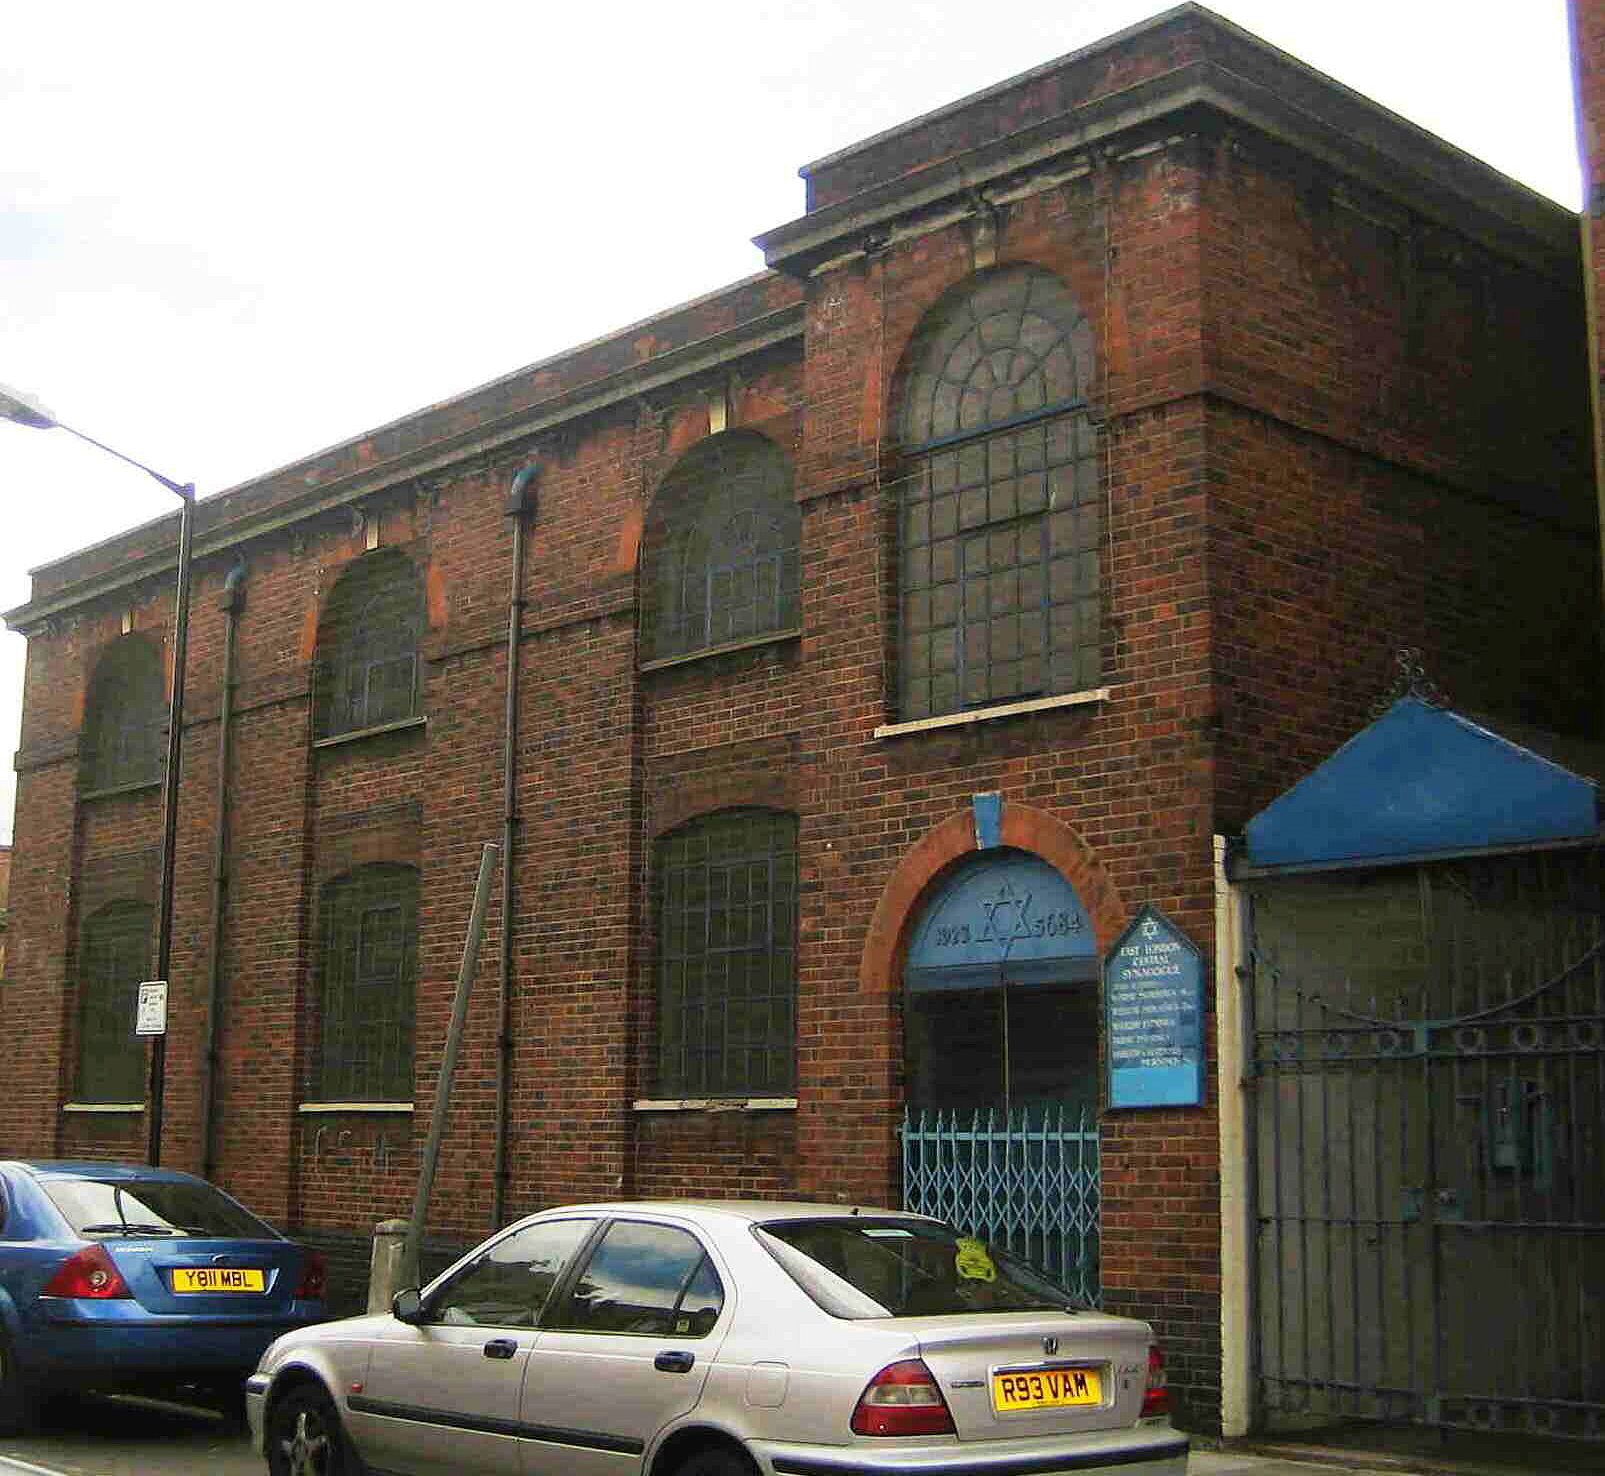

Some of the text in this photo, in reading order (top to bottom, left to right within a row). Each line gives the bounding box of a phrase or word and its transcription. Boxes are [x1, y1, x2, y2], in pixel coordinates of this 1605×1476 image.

[221, 1271, 254, 1287] MBL
[1002, 1372, 1089, 1402] R93 VAM
